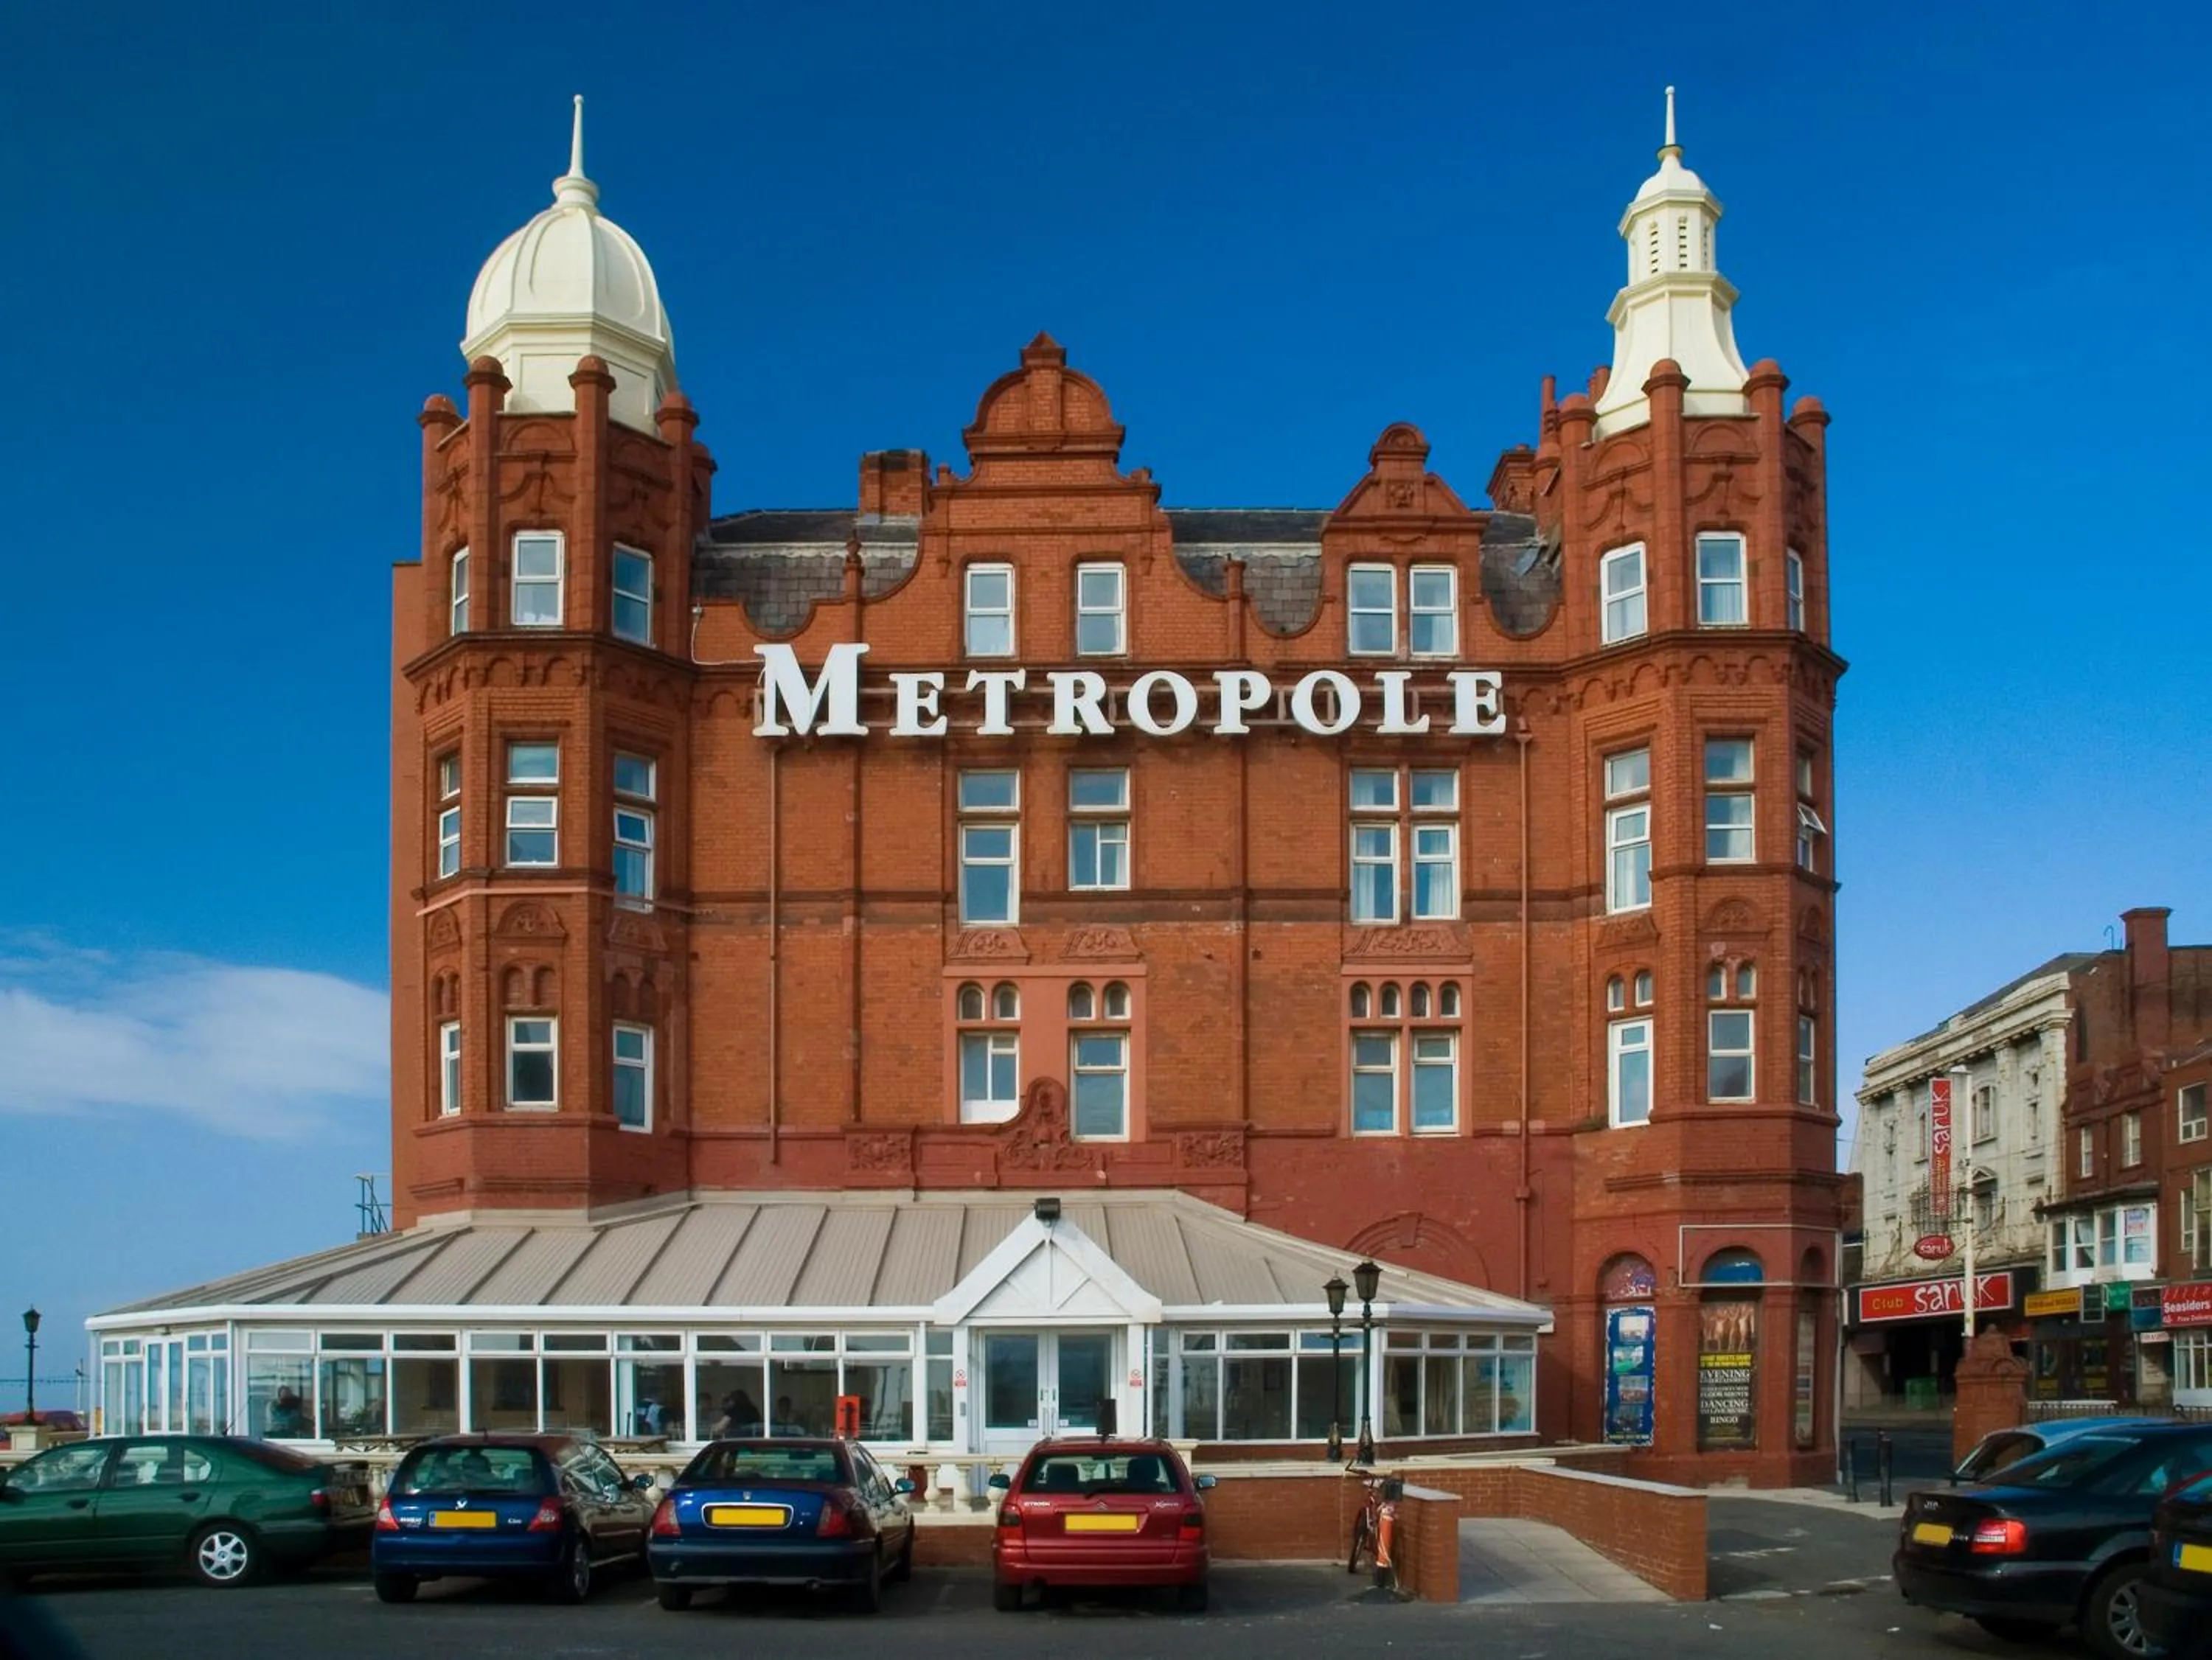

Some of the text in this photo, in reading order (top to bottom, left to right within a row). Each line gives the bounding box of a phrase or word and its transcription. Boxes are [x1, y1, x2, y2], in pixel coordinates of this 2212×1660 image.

[753, 642, 1507, 737] METROPOLE
[1933, 1090, 1951, 1155] sanuk
[1920, 1238, 1950, 1255] sanuk
[1872, 1297, 1905, 1310] Club
[2164, 1300, 2211, 1313] Seasiders
[1700, 1370, 1750, 1378] EVENING
[1700, 1400, 1748, 1408] DANCING
[1710, 1416, 1739, 1424] BINGO
